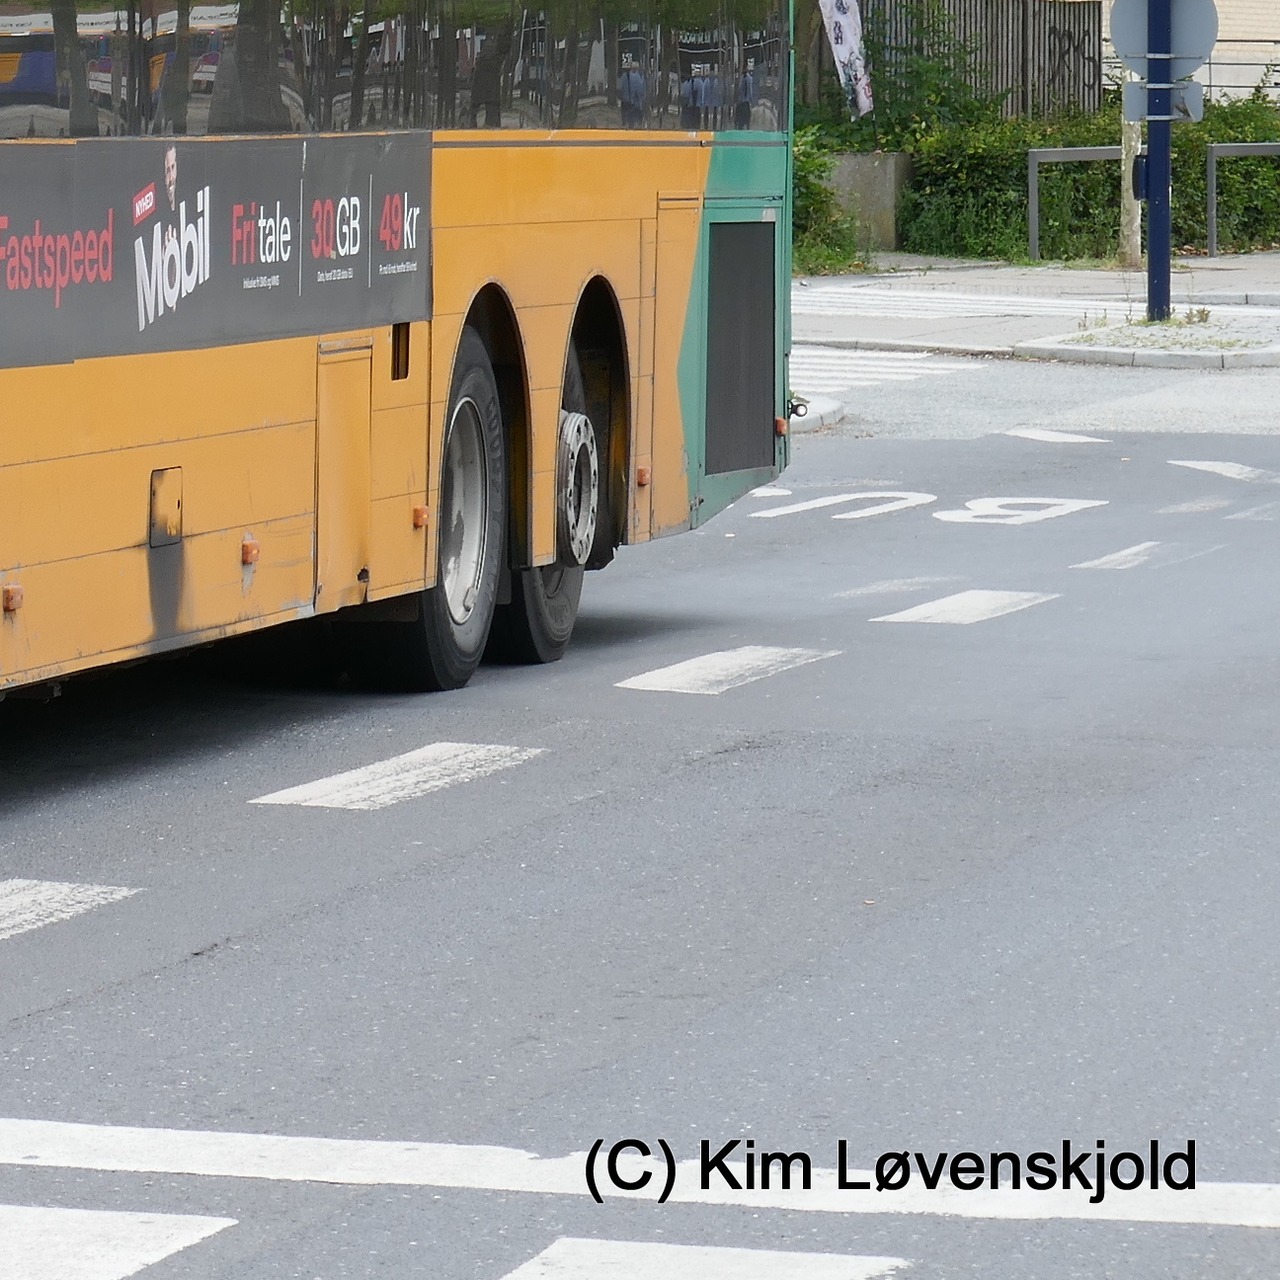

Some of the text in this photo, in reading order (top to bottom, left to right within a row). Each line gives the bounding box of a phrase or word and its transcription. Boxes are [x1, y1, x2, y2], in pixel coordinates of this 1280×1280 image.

[135, 190, 155, 218] NYHED
[231, 200, 292, 265] Fri tale
[310, 196, 361, 260] 30 GB
[379, 191, 421, 252] 49 kr
[134, 185, 211, 333] Mobil
[747, 486, 1110, 525] BU
